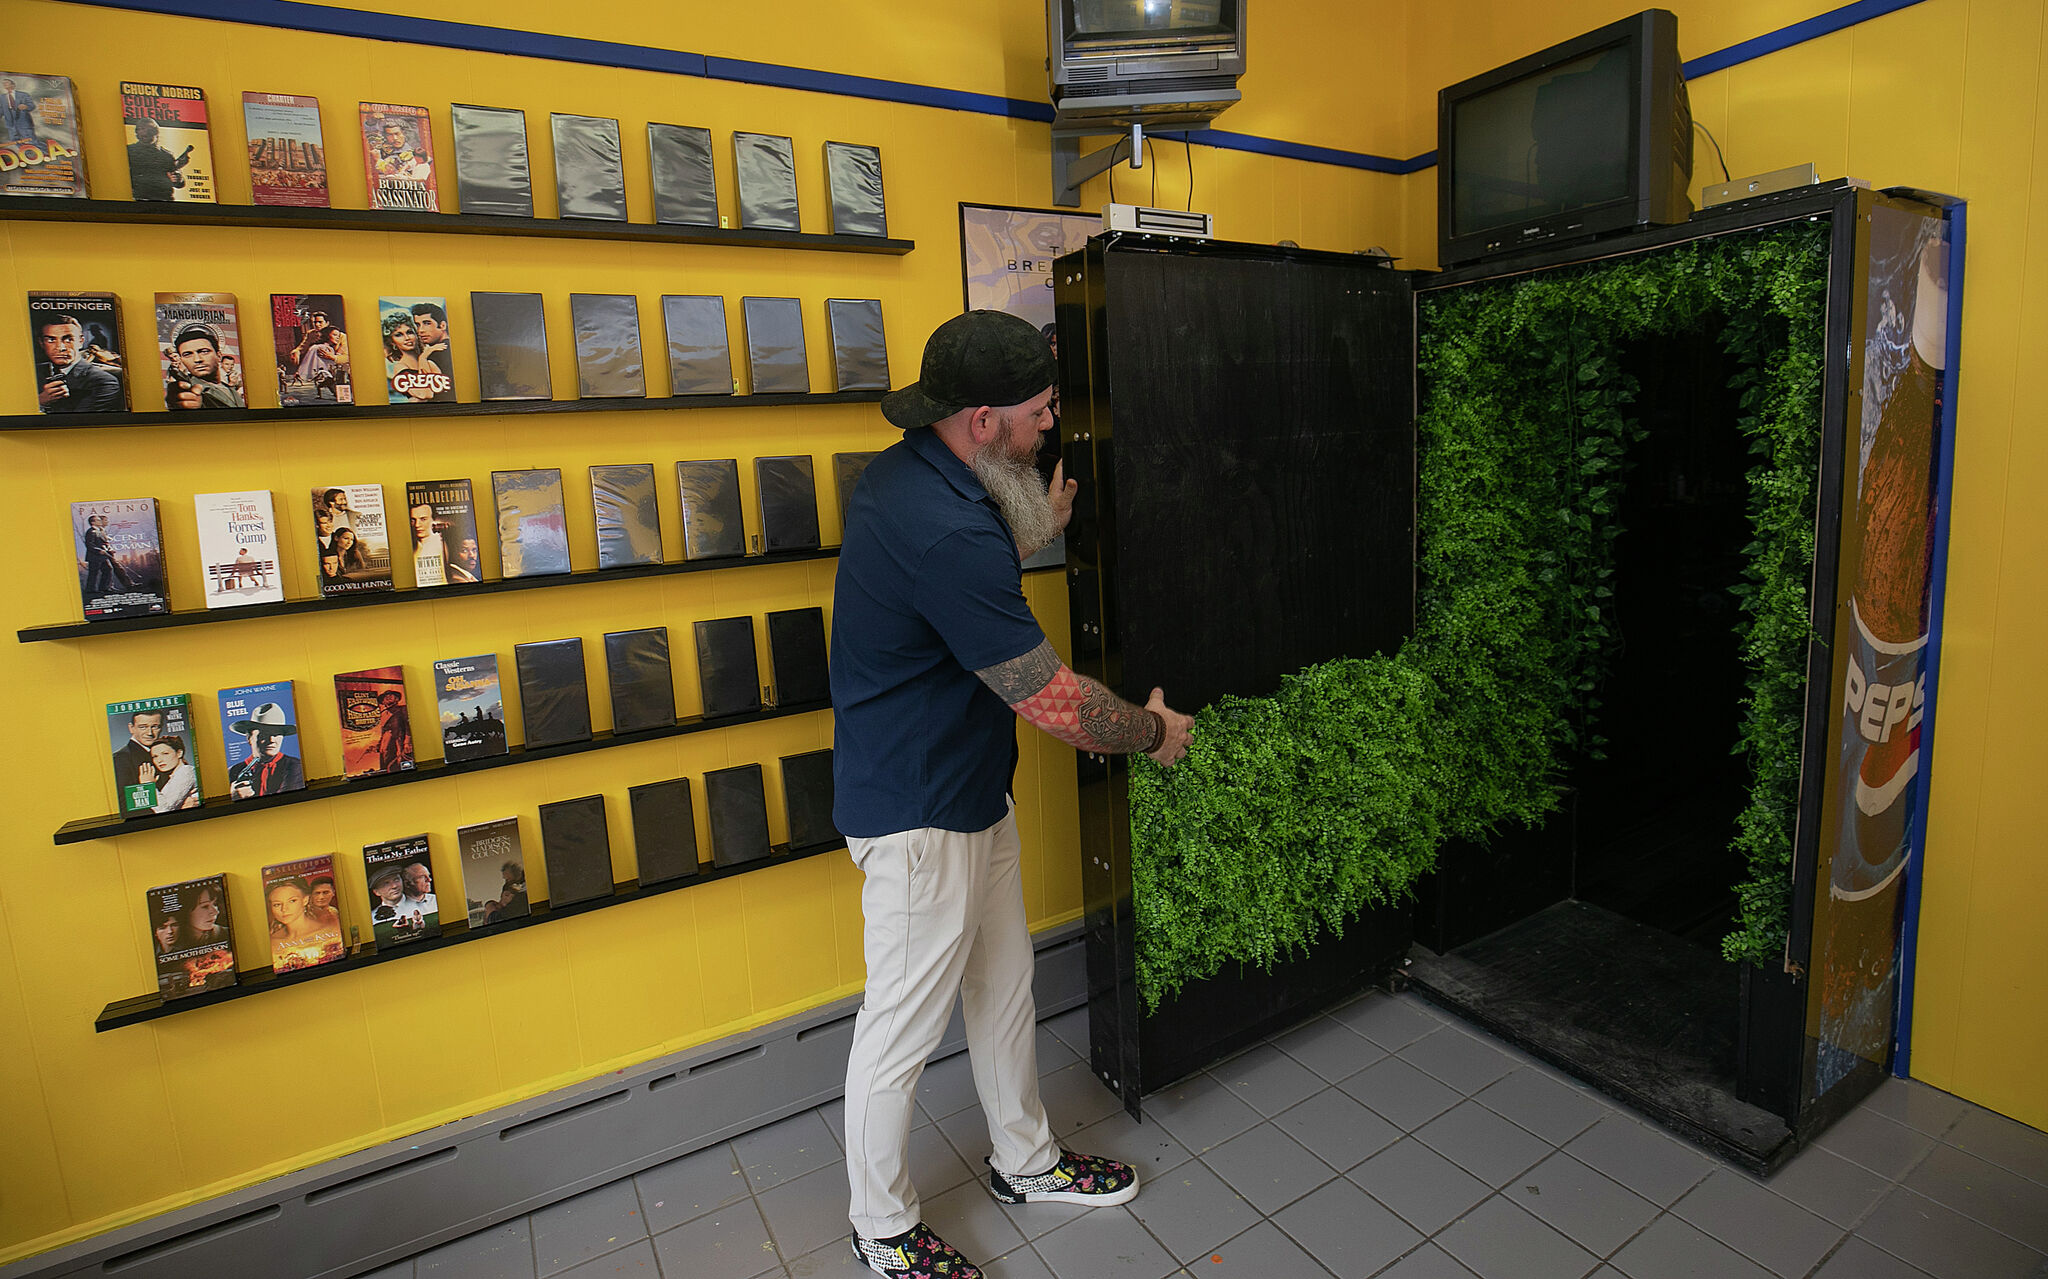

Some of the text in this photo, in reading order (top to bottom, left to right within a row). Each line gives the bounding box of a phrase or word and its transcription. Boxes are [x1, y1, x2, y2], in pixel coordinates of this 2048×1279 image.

[122, 83, 201, 100] CHUCK NORRIS
[123, 95, 161, 109] CODE
[124, 107, 181, 120] SILENCE
[0, 139, 78, 171] D.O.A.
[379, 179, 426, 191] BUDDHA
[372, 187, 438, 211] ASSASSINATOR
[31, 302, 112, 311] GOLDFINGER
[164, 310, 225, 323] MANCHURIAN
[394, 374, 451, 393] GREASE
[409, 490, 470, 505] PHILADELPHIA
[78, 503, 149, 515] PACINO
[237, 504, 256, 512] Tom
[232, 512, 259, 521] Hanks
[228, 522, 264, 533] Forrest
[108, 533, 145, 542] SCENT
[236, 533, 267, 544] Gump
[325, 583, 345, 592] GOOD
[361, 580, 392, 588] HUNTING
[435, 661, 460, 670] Classic
[443, 666, 475, 674] Westerns
[234, 687, 252, 695] JOHN
[114, 697, 179, 712] JOHN WAYNE
[226, 700, 245, 709] BLUE
[227, 708, 248, 717] STEEL
[135, 798, 149, 807] MAN
[471, 840, 511, 853] MADISON
[366, 855, 383, 863] This
[391, 850, 403, 859] My
[404, 846, 428, 855] Father
[160, 955, 179, 964] SOME
[213, 944, 229, 952] SON
